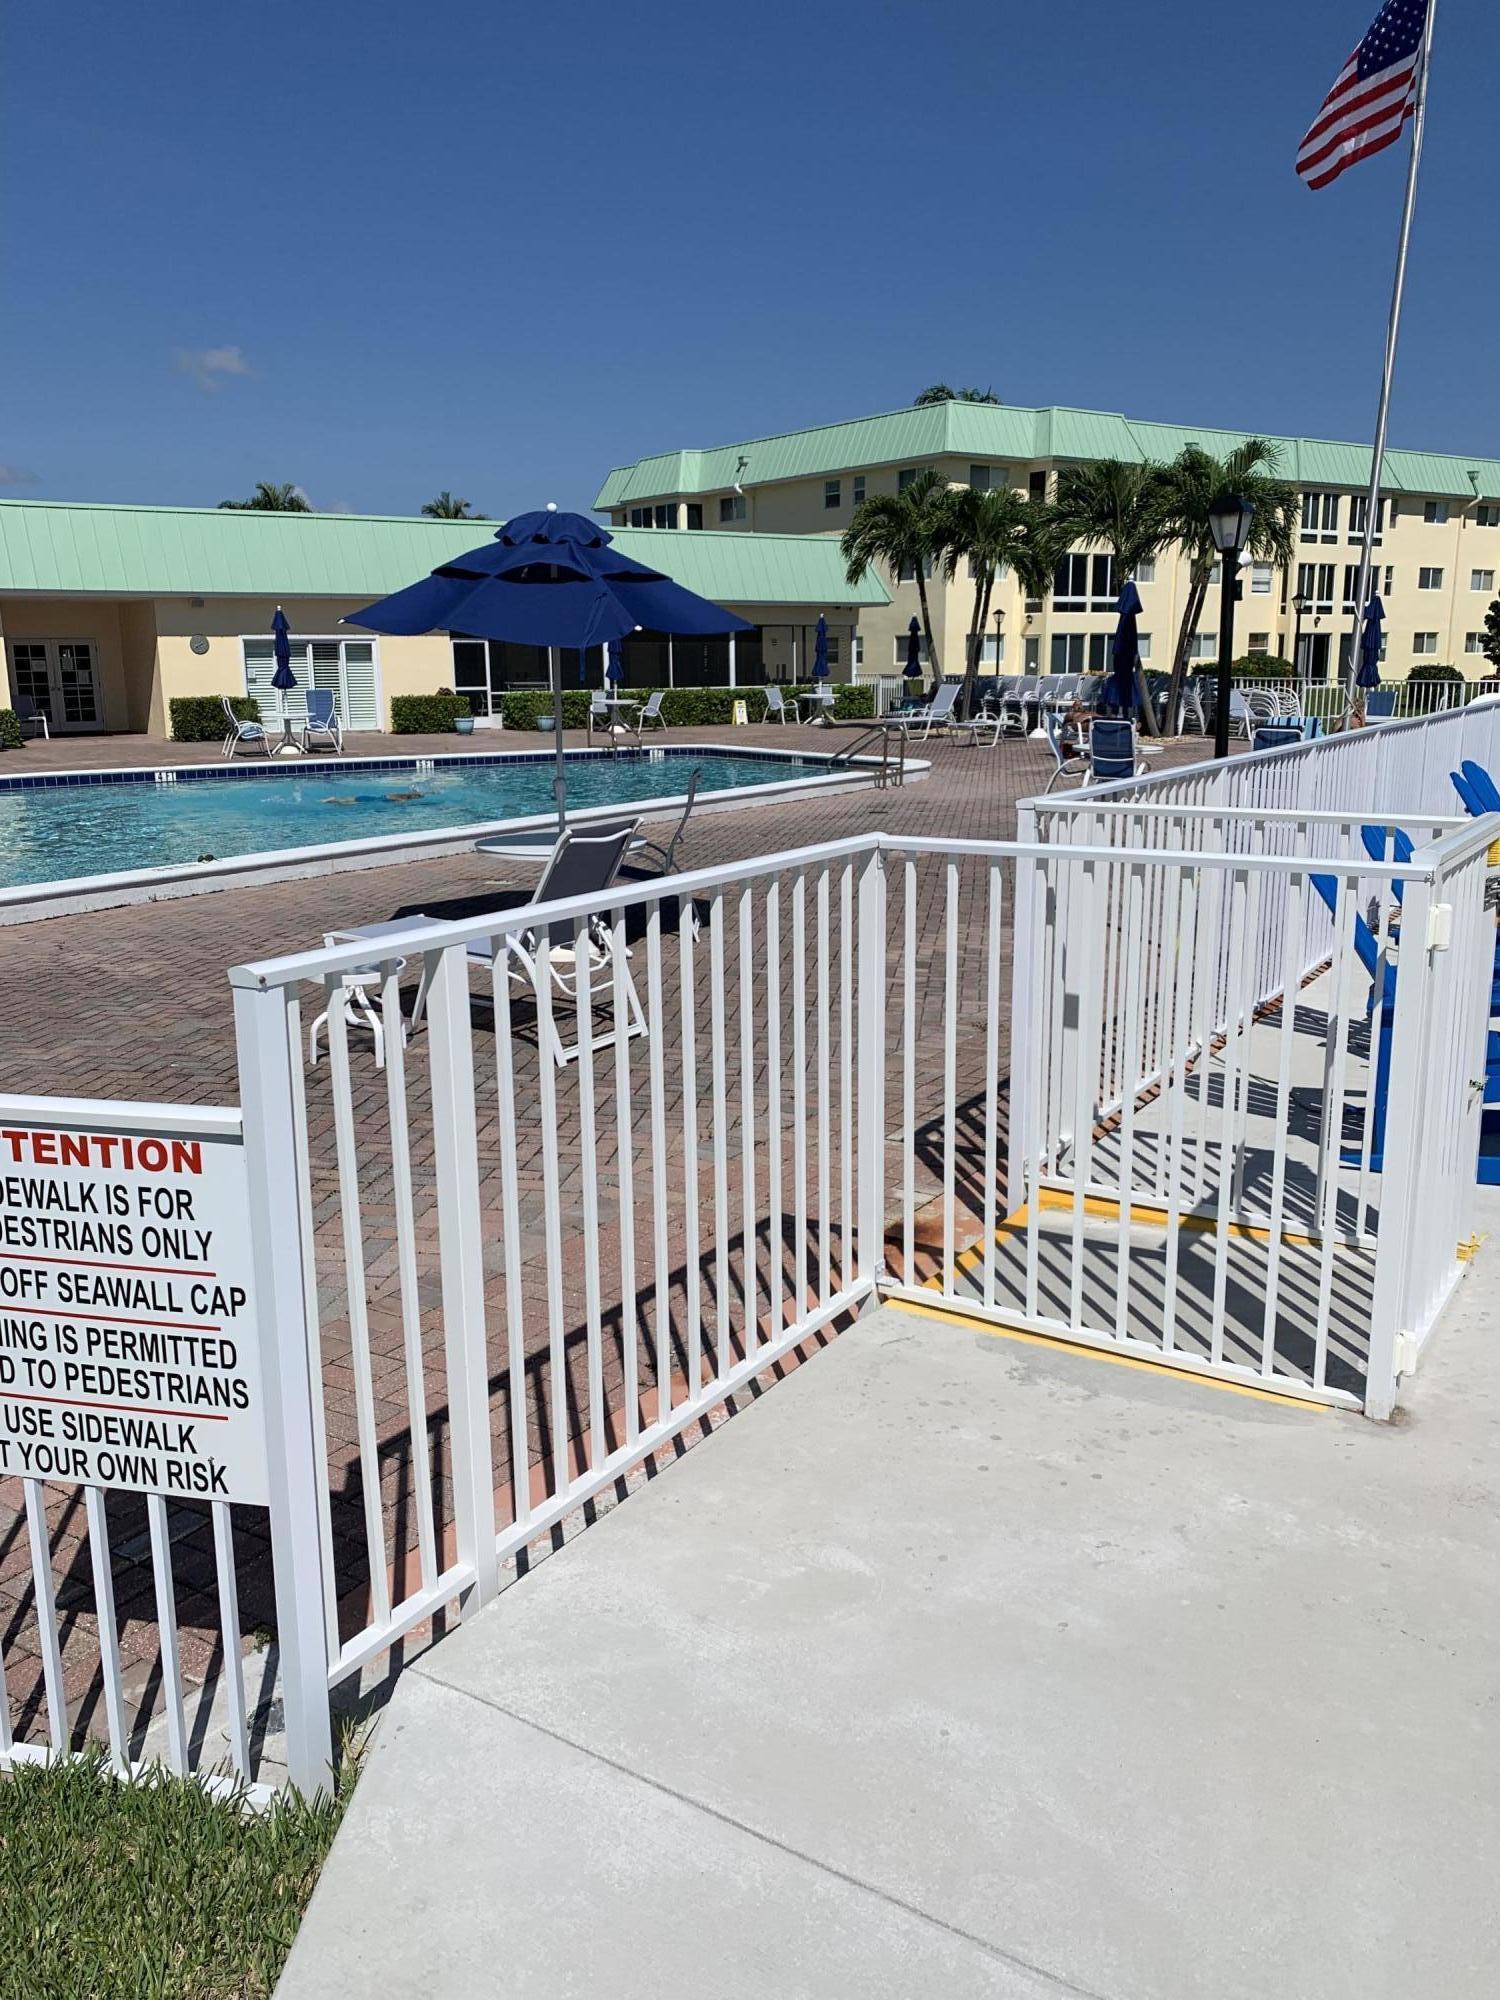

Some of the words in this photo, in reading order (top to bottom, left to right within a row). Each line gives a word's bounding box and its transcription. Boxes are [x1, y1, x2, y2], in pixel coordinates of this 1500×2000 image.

[0, 1130, 203, 1174] TENTION
[0, 1176, 98, 1214] EWALK
[105, 1183, 130, 1216] IS
[138, 1186, 195, 1221] FOR
[0, 1215, 133, 1256] ESTRIANS
[142, 1226, 213, 1261] ONLY
[1, 1266, 48, 1300] OFF
[57, 1271, 183, 1313] SEAWALL
[190, 1283, 246, 1317] CAP
[0, 1318, 47, 1351] ING
[54, 1323, 78, 1355] IS
[86, 1327, 237, 1370] PERMITTED
[22, 1357, 57, 1389] TO
[64, 1362, 249, 1409] PEDESTRIANS
[4, 1404, 54, 1438] USE
[61, 1411, 197, 1454] SIDEWALK
[17, 1441, 90, 1478] YOUR
[97, 1451, 158, 1487] OWN
[166, 1459, 229, 1495] RISK
